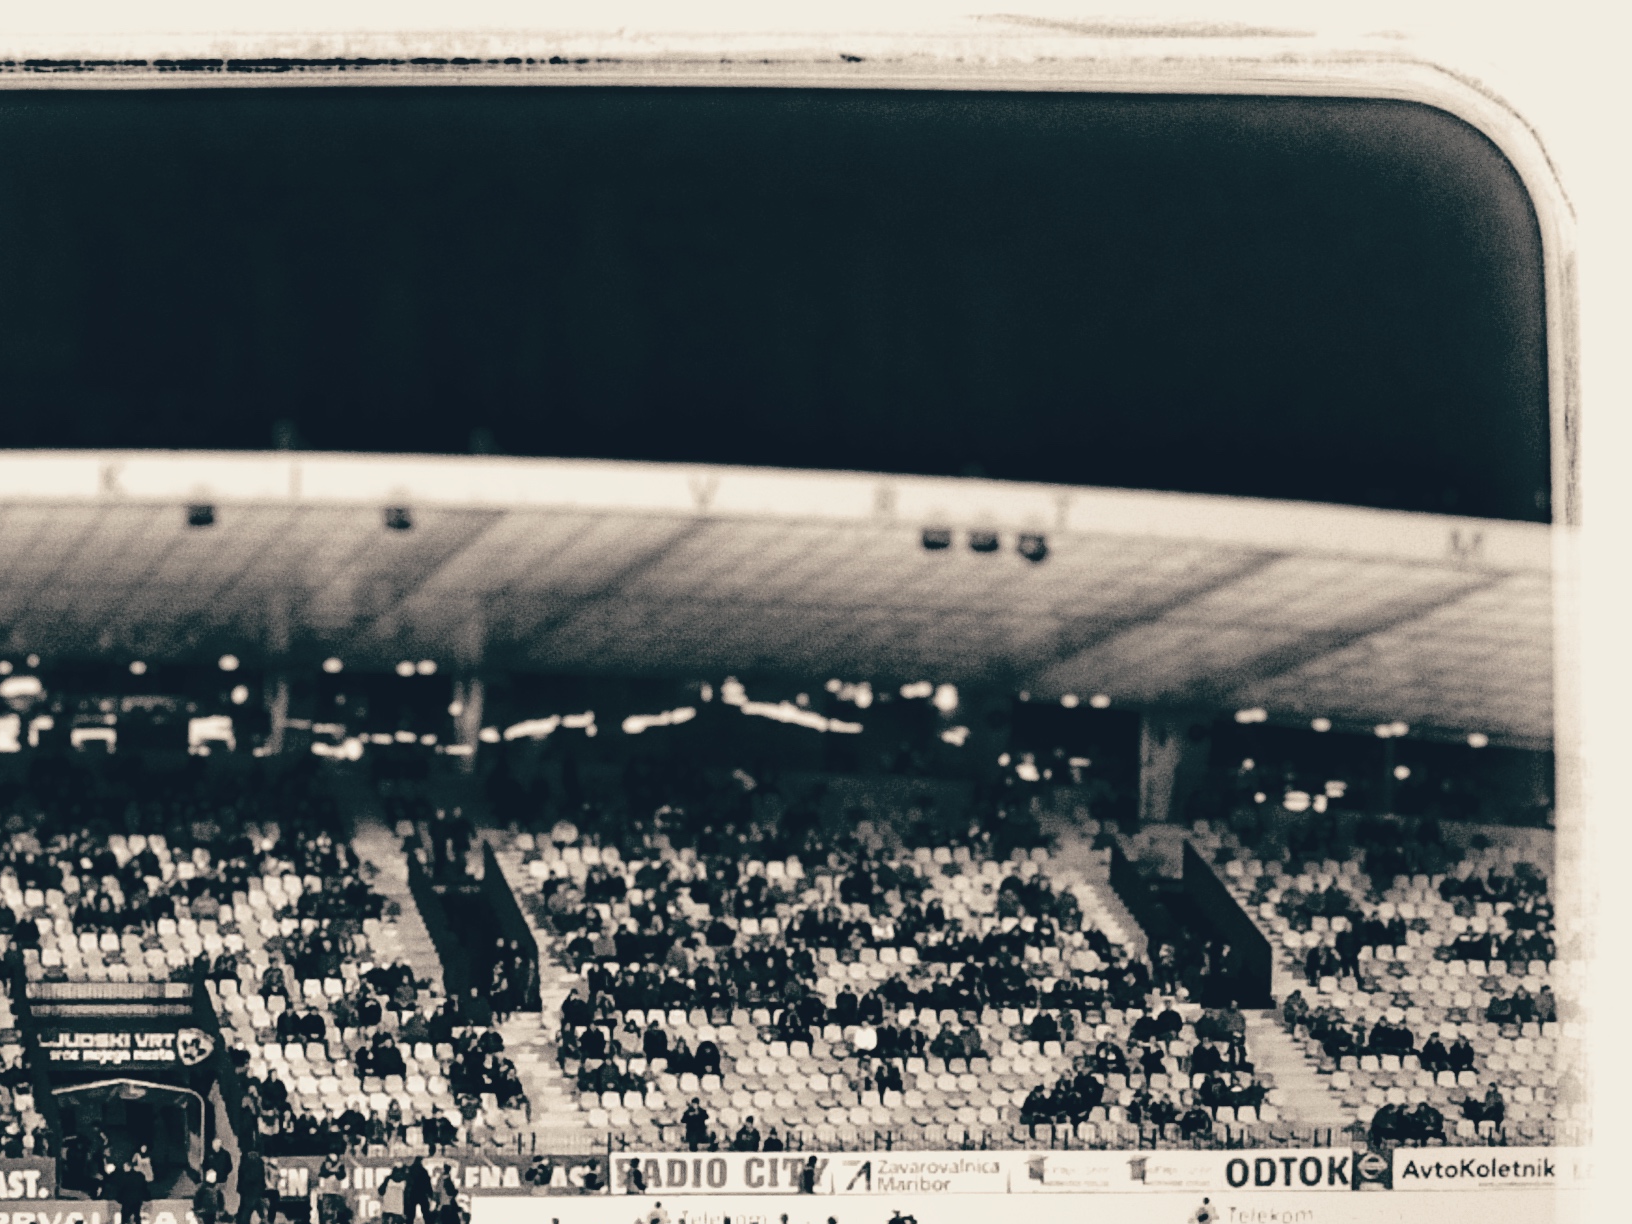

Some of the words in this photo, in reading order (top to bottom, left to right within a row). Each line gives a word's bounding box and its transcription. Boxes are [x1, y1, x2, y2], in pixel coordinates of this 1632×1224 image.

[134, 1033, 176, 1048] VRT
[878, 1158, 1001, 1175] Zavarovalnica
[1225, 1156, 1349, 1188] ODTOK
[1401, 1158, 1556, 1179] AvtoKoletnik
[878, 1177, 951, 1192] Maribor
[1227, 1206, 1315, 1224] Telekom
